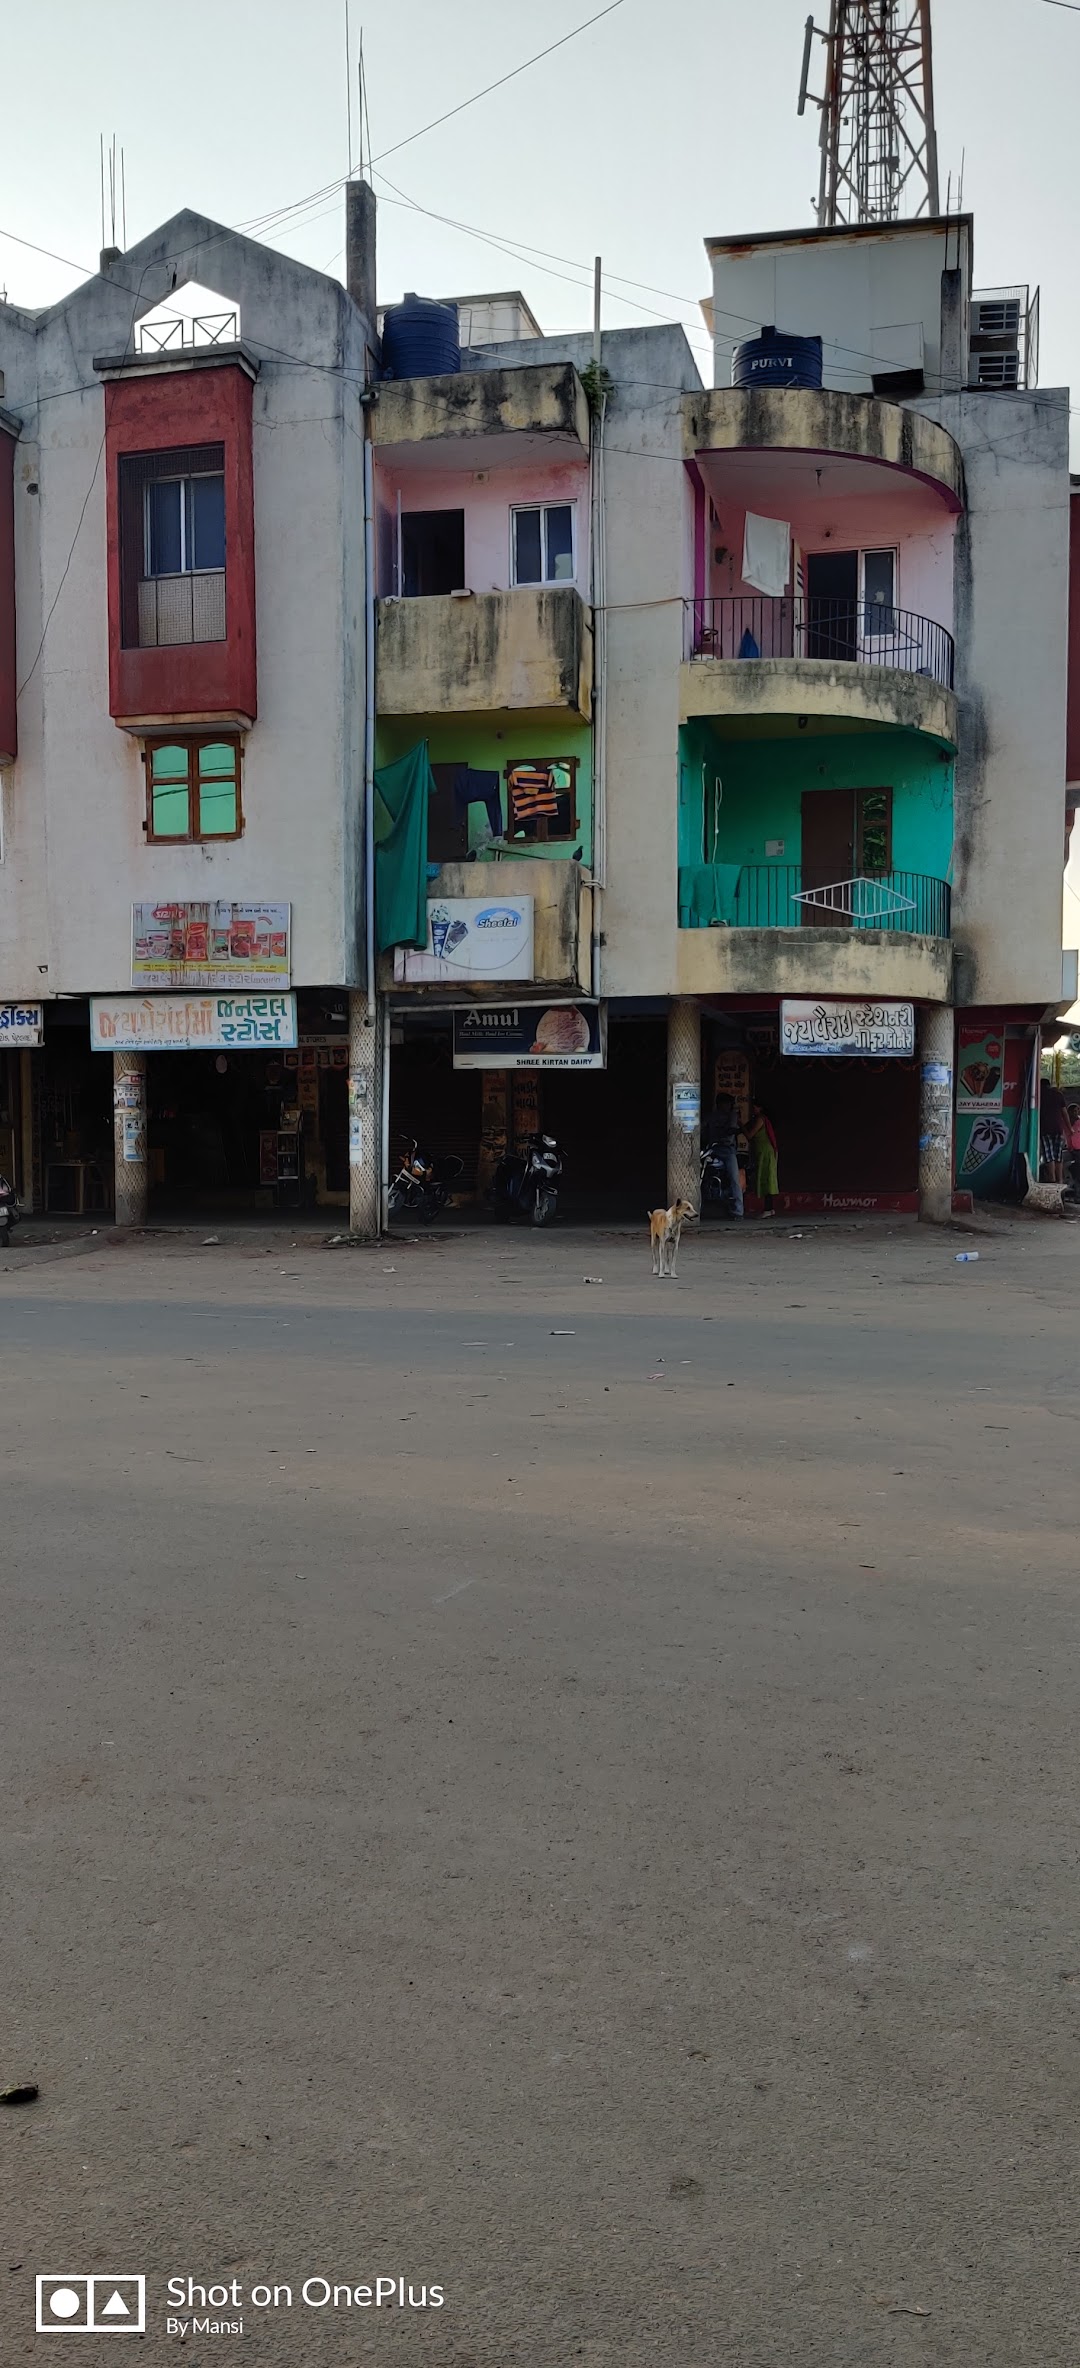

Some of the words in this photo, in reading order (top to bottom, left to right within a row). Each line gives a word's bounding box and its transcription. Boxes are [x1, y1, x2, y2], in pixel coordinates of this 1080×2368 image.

[751, 357, 794, 371] PURVI
[477, 916, 519, 929] Sheetal
[217, 999, 287, 1017] જનરલ
[463, 1008, 520, 1027] Amul
[220, 1018, 281, 1041] સ્ટોર્સ
[784, 1020, 815, 1044] જય
